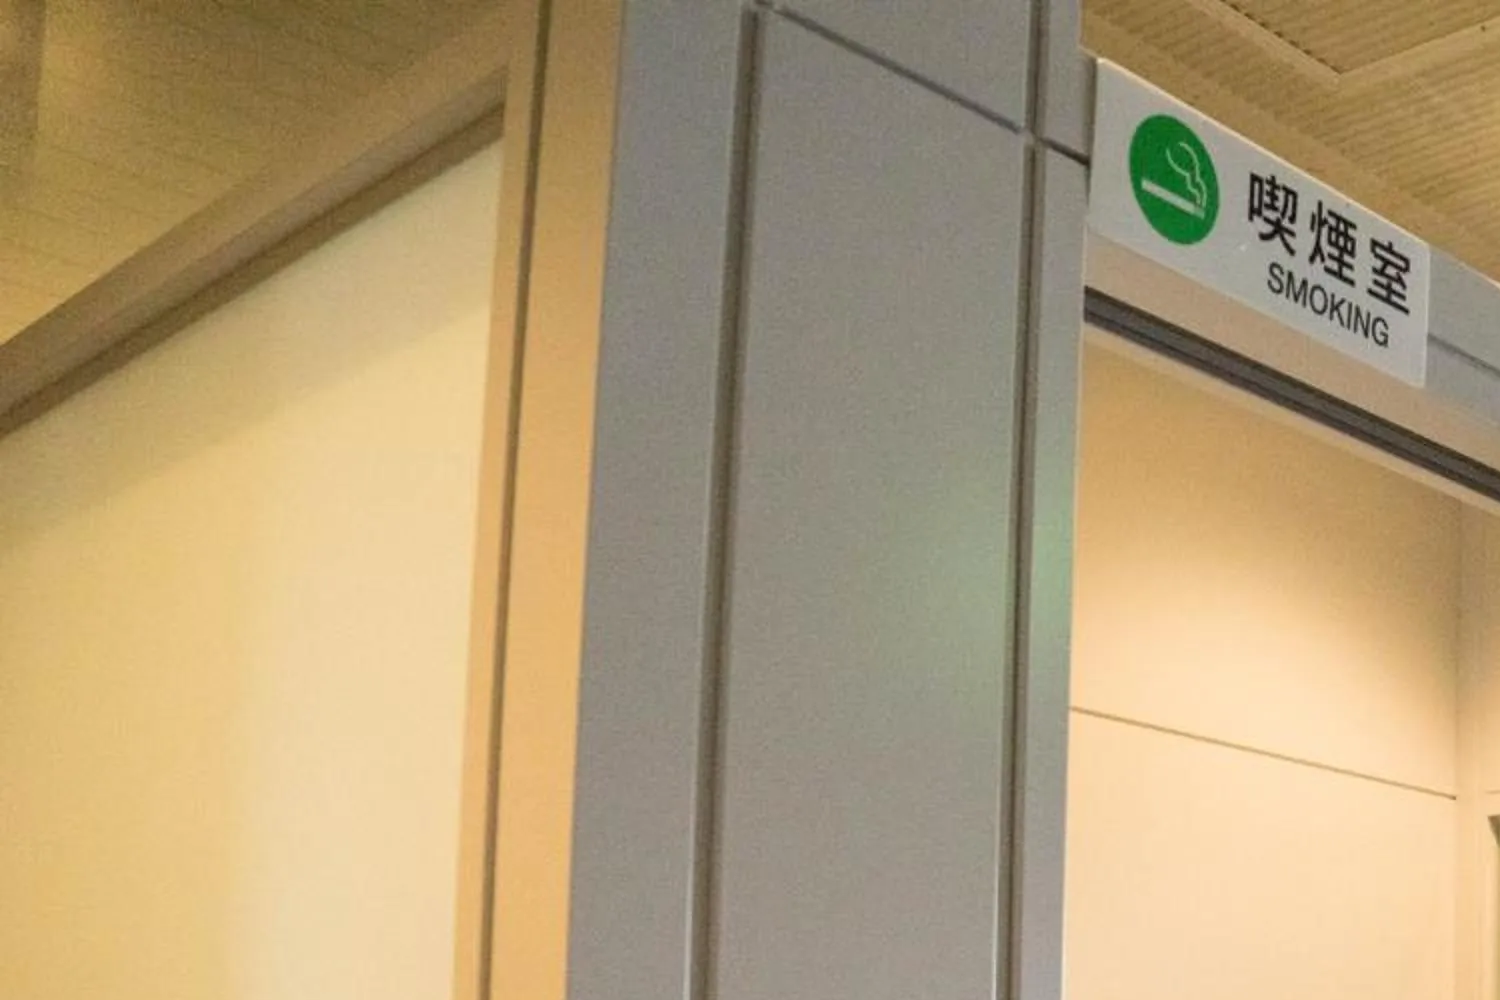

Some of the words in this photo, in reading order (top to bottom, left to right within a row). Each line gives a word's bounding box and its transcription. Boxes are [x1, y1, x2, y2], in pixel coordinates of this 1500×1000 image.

[1247, 172, 1411, 315] 喫煙室
[1266, 262, 1390, 348] SMOKING
